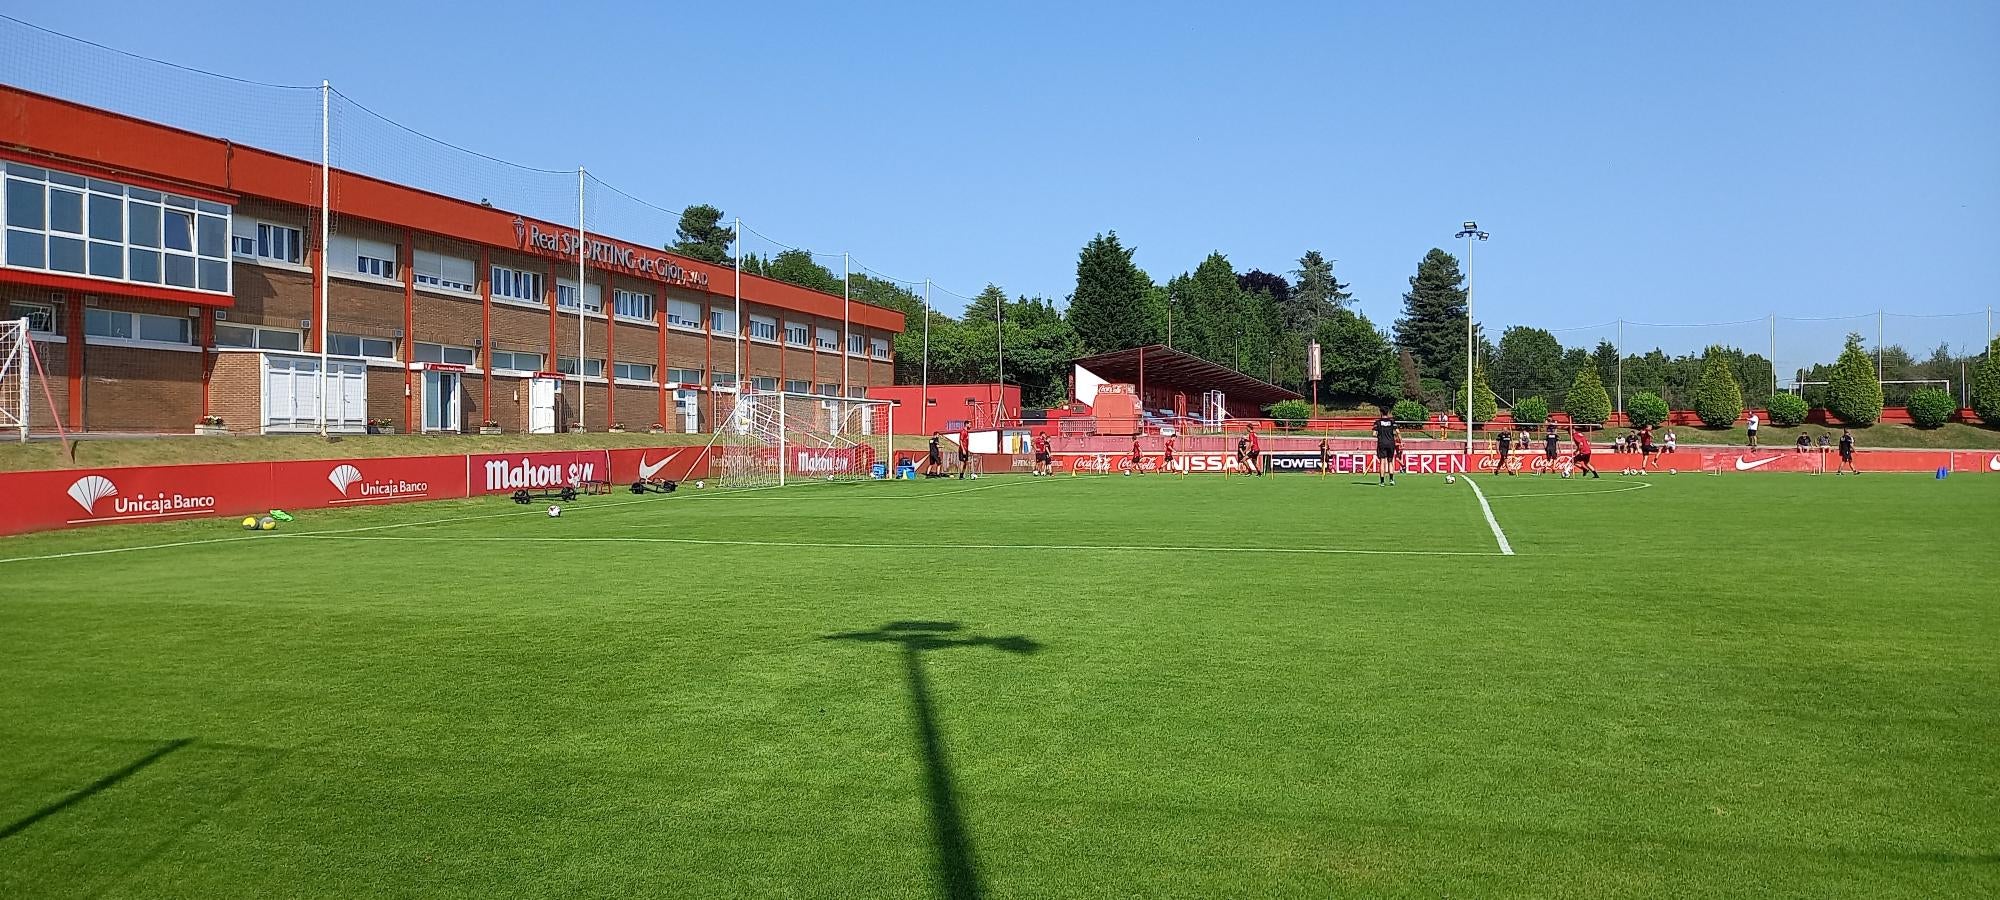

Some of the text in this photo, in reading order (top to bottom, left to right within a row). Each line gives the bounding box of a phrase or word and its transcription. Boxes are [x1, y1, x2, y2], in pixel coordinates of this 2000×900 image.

[530, 224, 559, 252] Real
[560, 232, 635, 269] SPORTING
[638, 252, 654, 273] de
[798, 451, 833, 471] Mahou
[485, 458, 562, 490] Mahou
[361, 479, 427, 496] Unicaja Banco
[115, 493, 214, 513] Unicaja Banco
